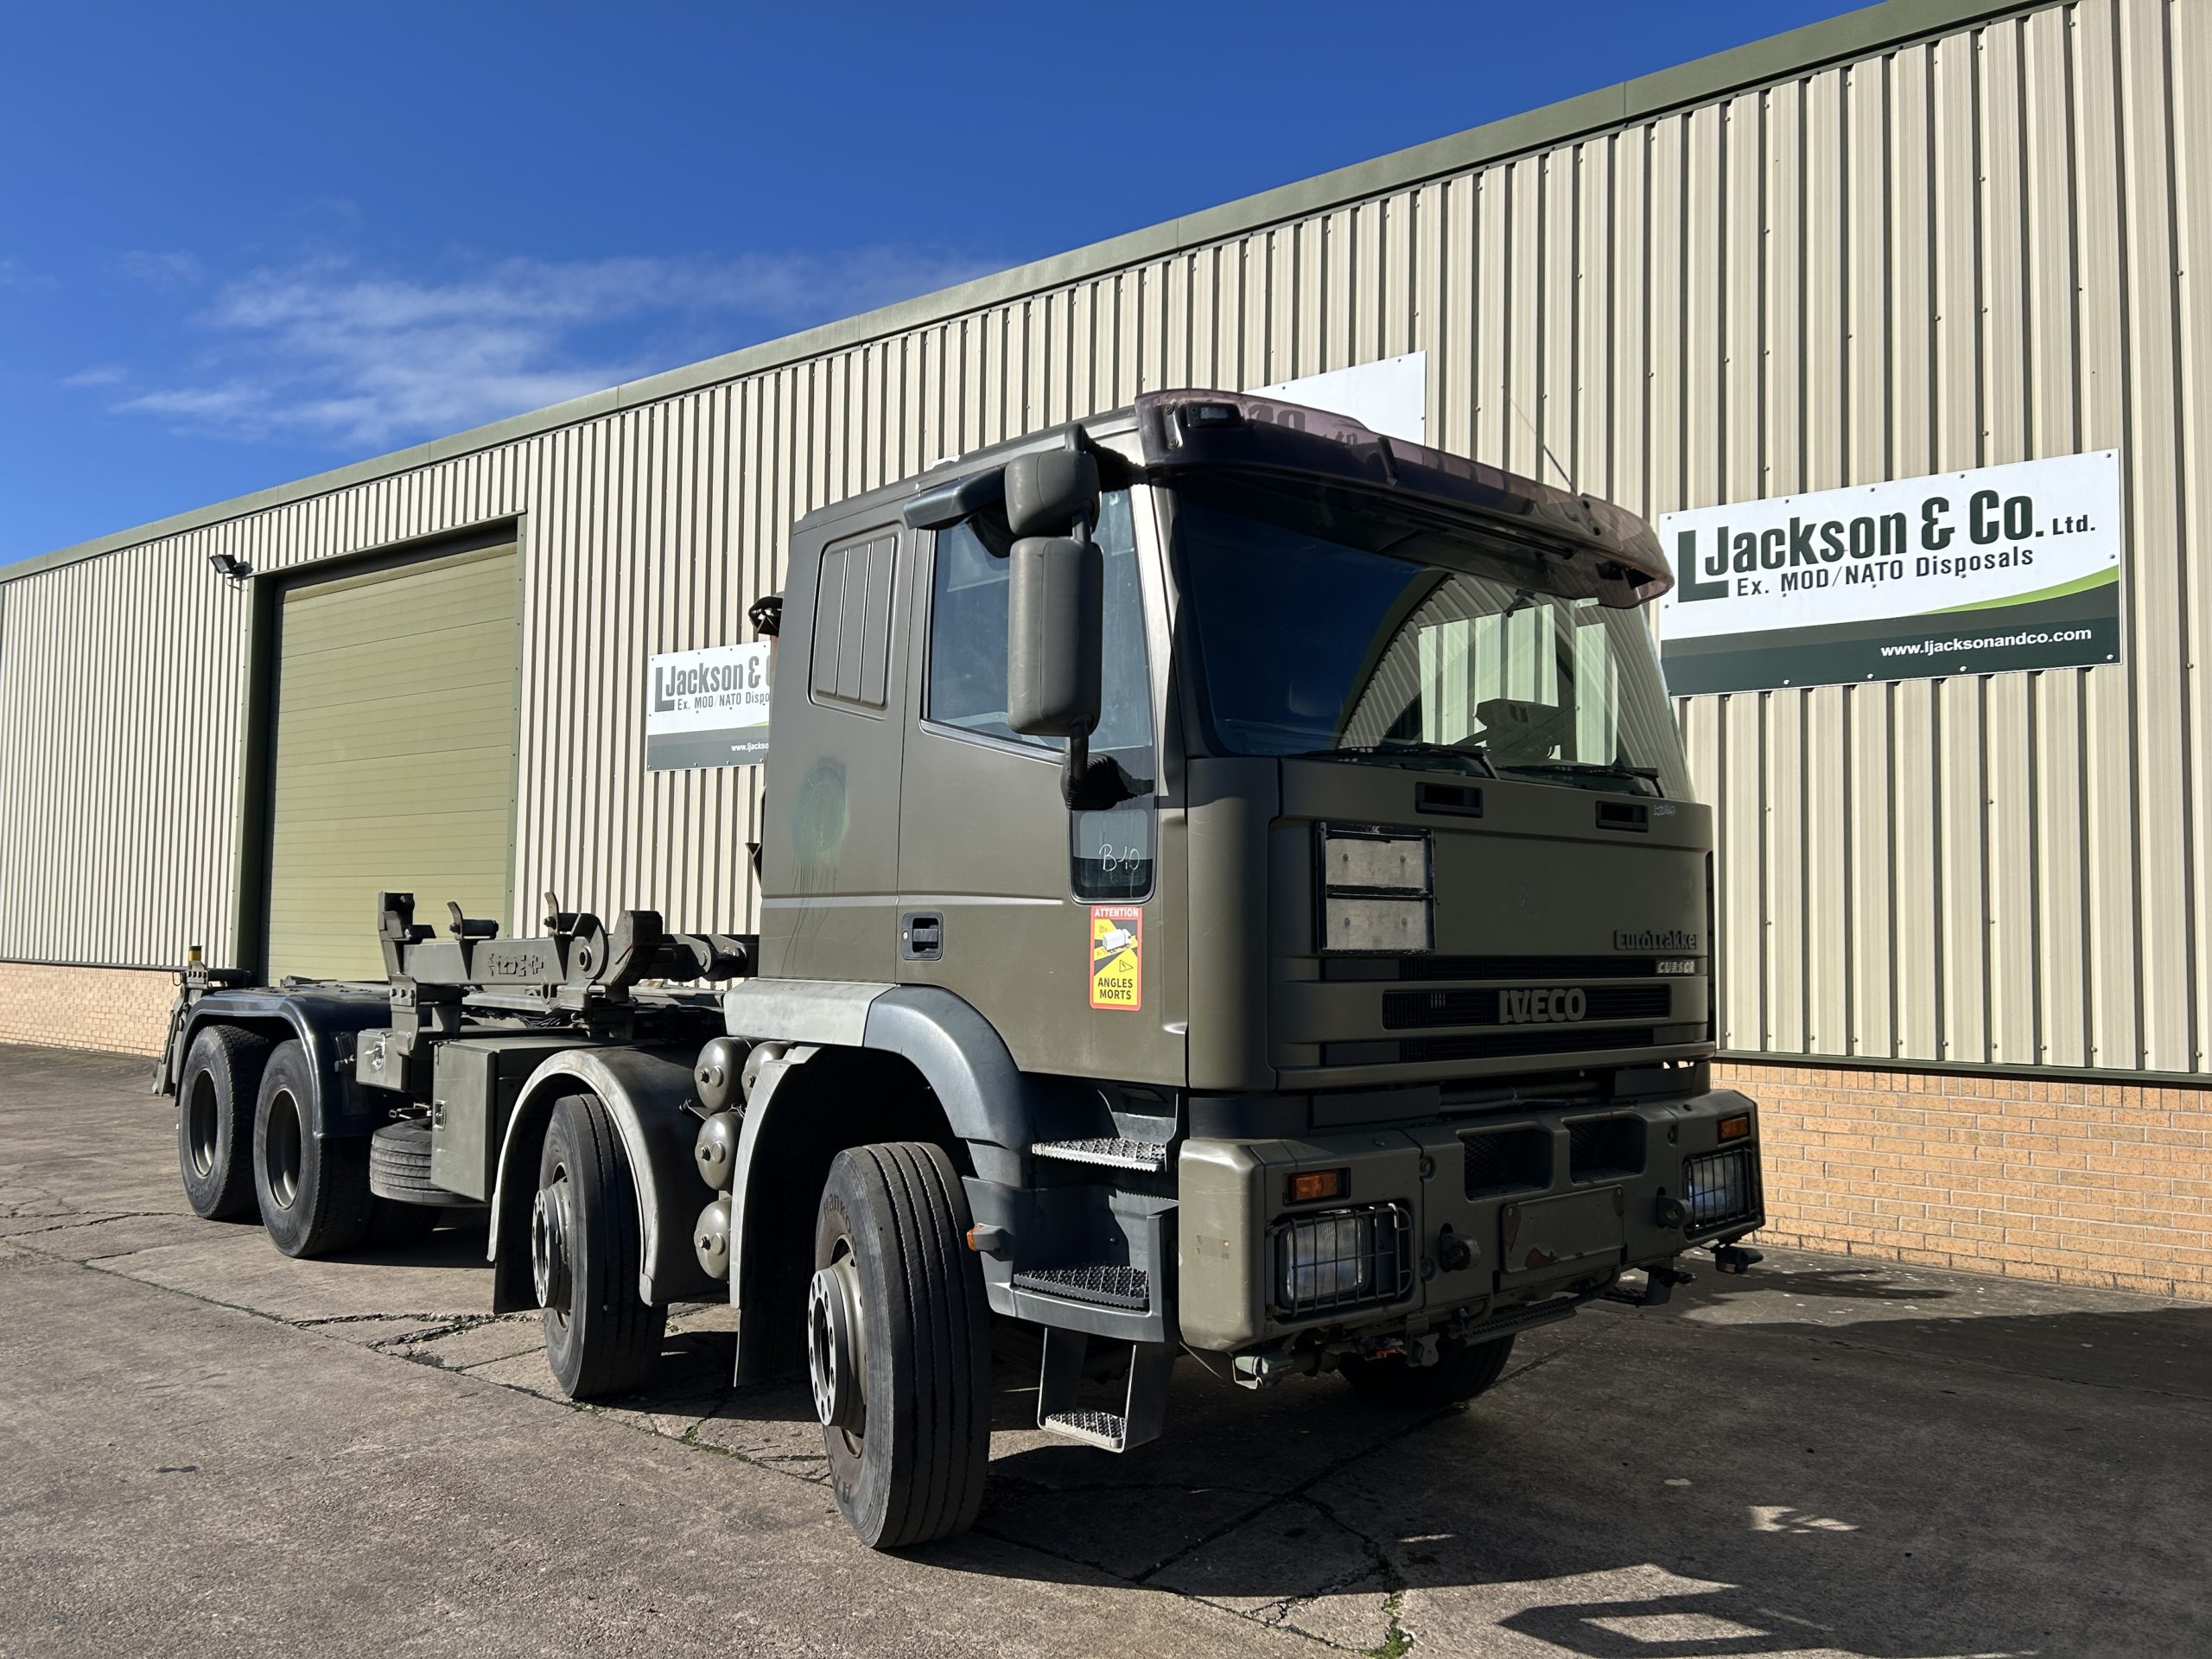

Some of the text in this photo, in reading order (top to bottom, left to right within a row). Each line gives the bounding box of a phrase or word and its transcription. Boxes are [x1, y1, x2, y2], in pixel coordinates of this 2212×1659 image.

[1921, 496, 1955, 551] &
[1969, 489, 2044, 545] Co.
[2052, 514, 2096, 536] Ltd.
[1737, 545, 2034, 597] Ex. MOD/NATO Disposals
[1880, 628, 2093, 658] www.ljacksonandco.com
[747, 655, 761, 689] &
[677, 690, 770, 711] Ex. MOD/NATO Dispo
[730, 741, 769, 753] www.ljackso
[1094, 907, 1140, 918] ATTENTION
[1097, 977, 1134, 989] ANGLES
[1099, 988, 1132, 1001] MORTS
[1499, 988, 1587, 1025] IVECO
